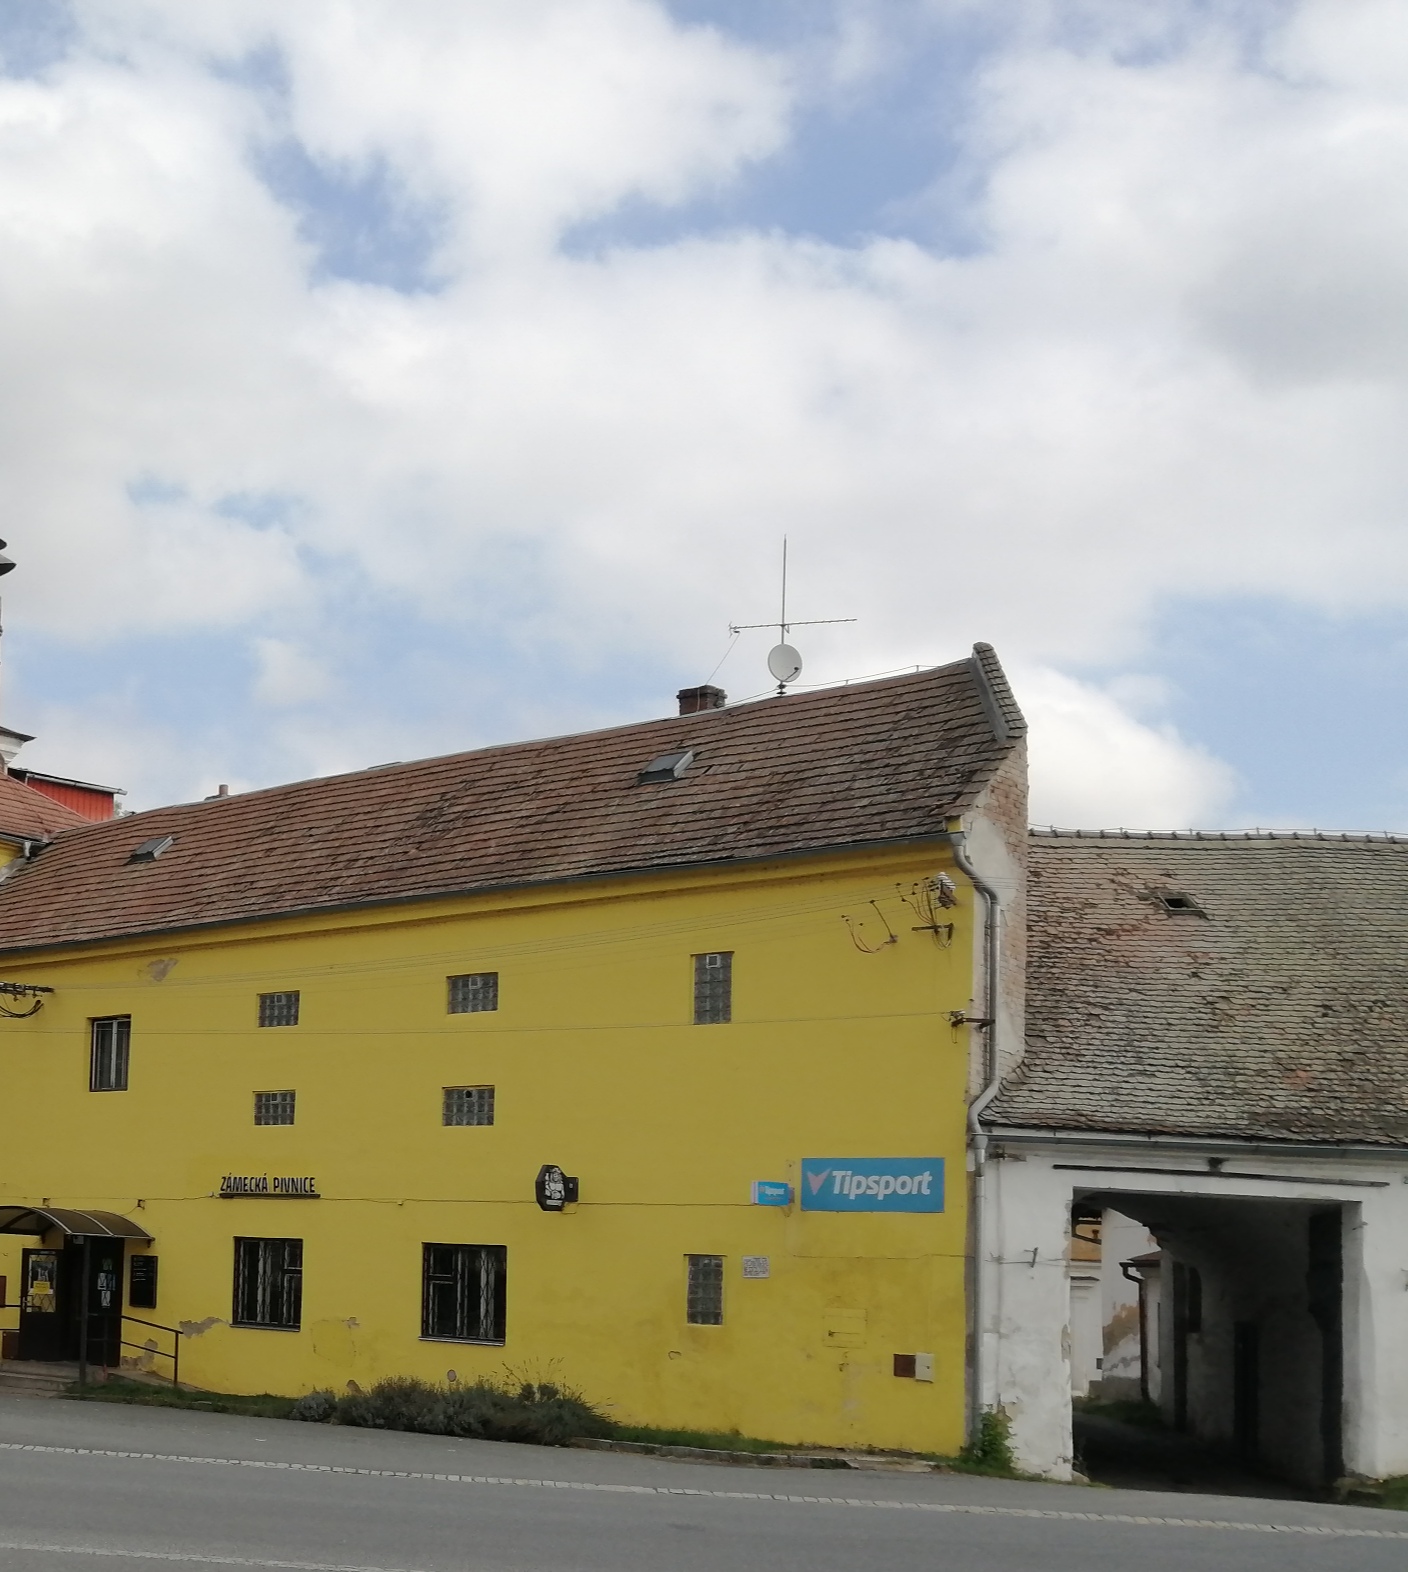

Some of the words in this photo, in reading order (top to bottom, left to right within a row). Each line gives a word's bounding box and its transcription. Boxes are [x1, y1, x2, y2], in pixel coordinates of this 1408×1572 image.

[220, 1172, 269, 1192] ZÁMECKÁ
[273, 1177, 316, 1193] PIVNICE
[832, 1170, 933, 1200] Tipsport
